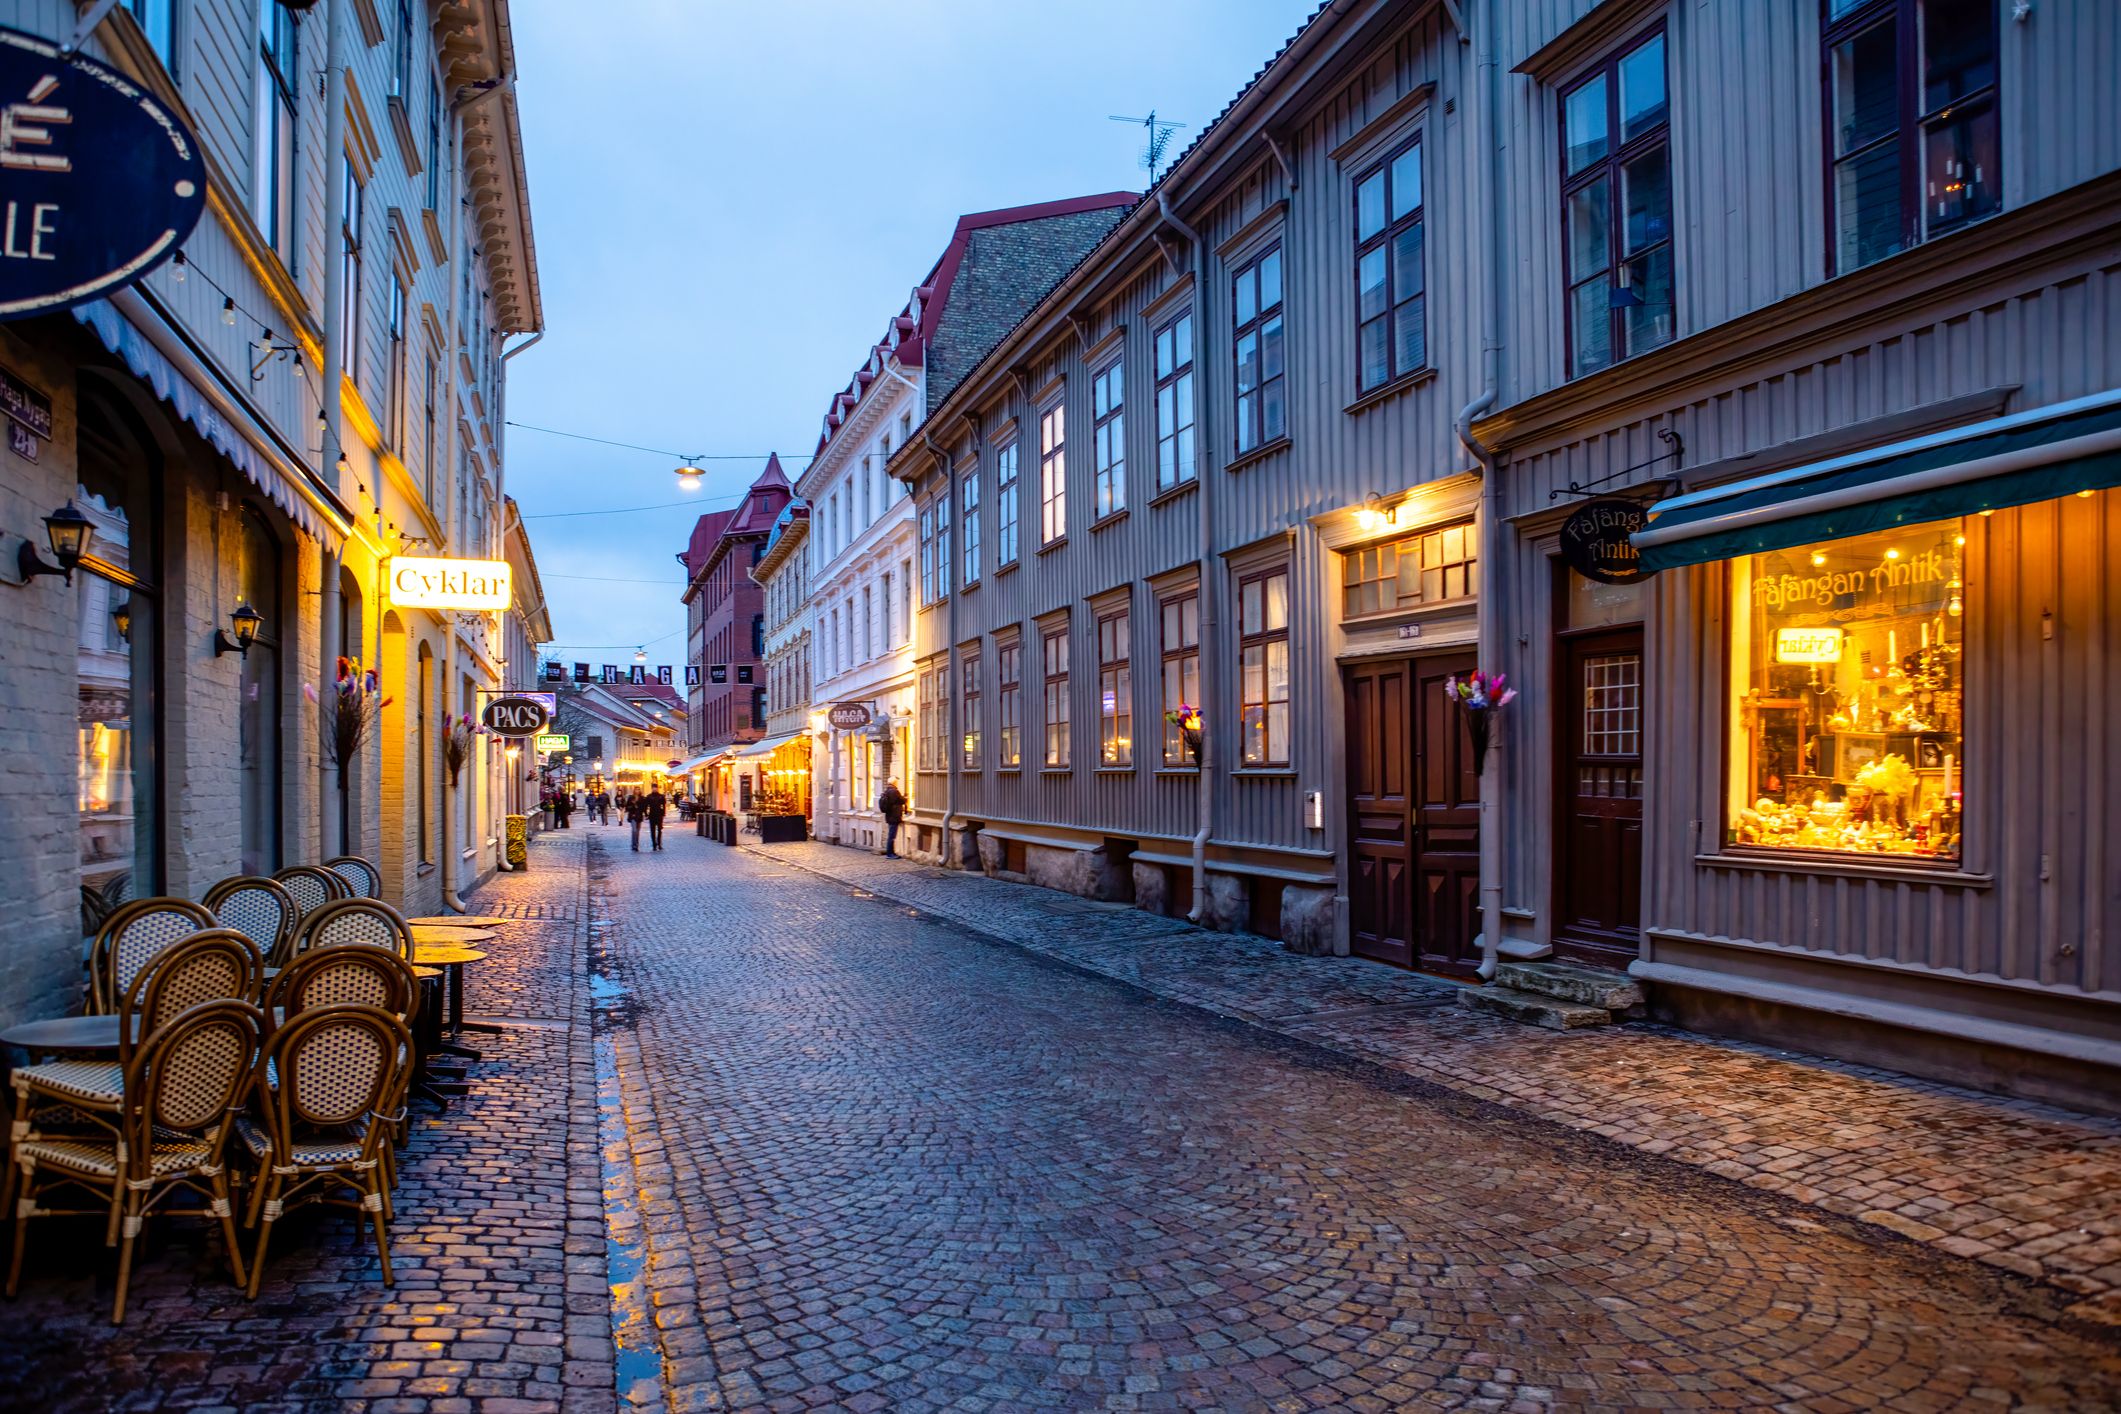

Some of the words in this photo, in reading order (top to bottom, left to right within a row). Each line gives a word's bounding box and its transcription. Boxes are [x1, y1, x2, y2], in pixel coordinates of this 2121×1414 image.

[396, 568, 505, 597] Cyklar
[1753, 570, 1865, 611] Fåfängan
[1869, 549, 1944, 594] Antik
[493, 705, 540, 728] PACS
